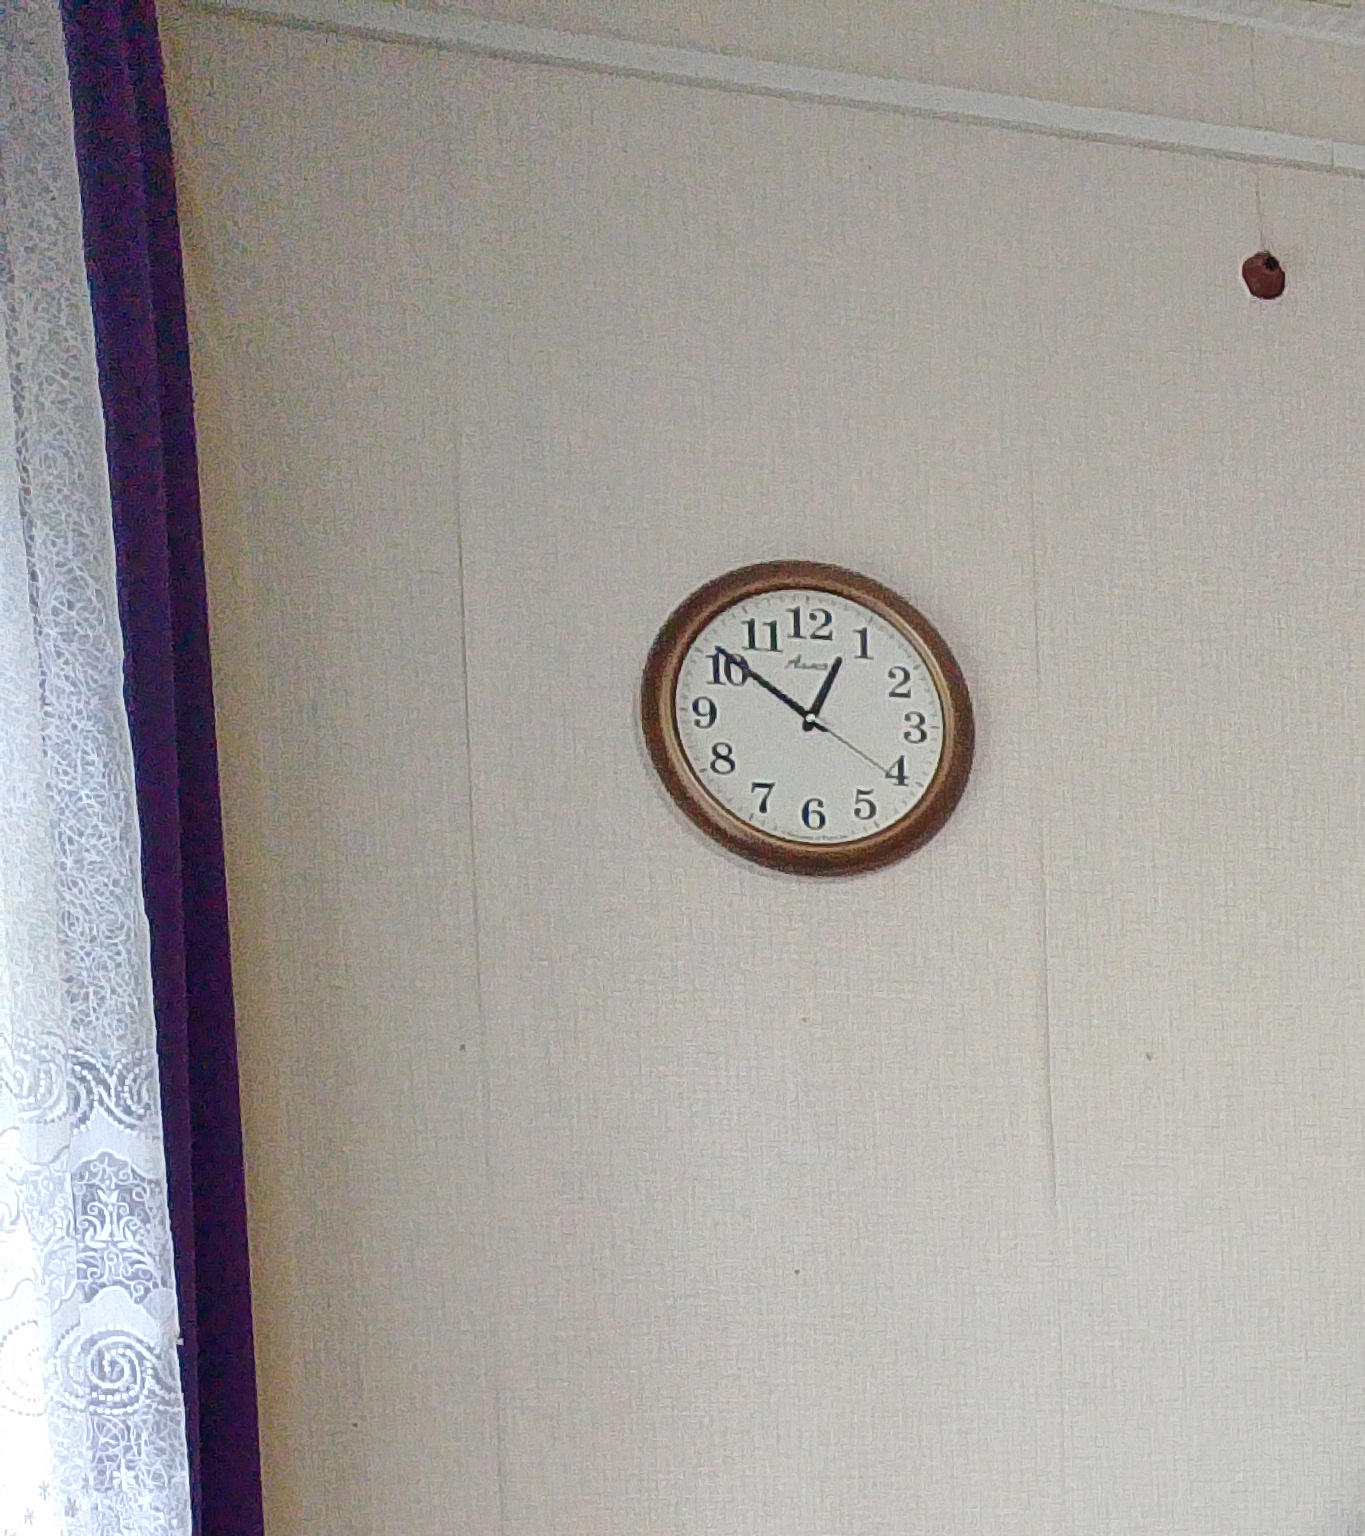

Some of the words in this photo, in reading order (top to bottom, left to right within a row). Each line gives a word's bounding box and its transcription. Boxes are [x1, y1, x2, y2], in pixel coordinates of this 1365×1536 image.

[741, 617, 783, 653] 11
[786, 605, 833, 641] 12
[853, 626, 874, 660] 1
[705, 650, 751, 687] 10
[887, 665, 912, 699] 2
[691, 696, 718, 730] 9
[903, 711, 928, 744] 3
[709, 742, 736, 775] 8
[885, 754, 909, 787] 4
[751, 782, 776, 814] 7
[801, 798, 826, 831] 6
[853, 788, 877, 820] 5
